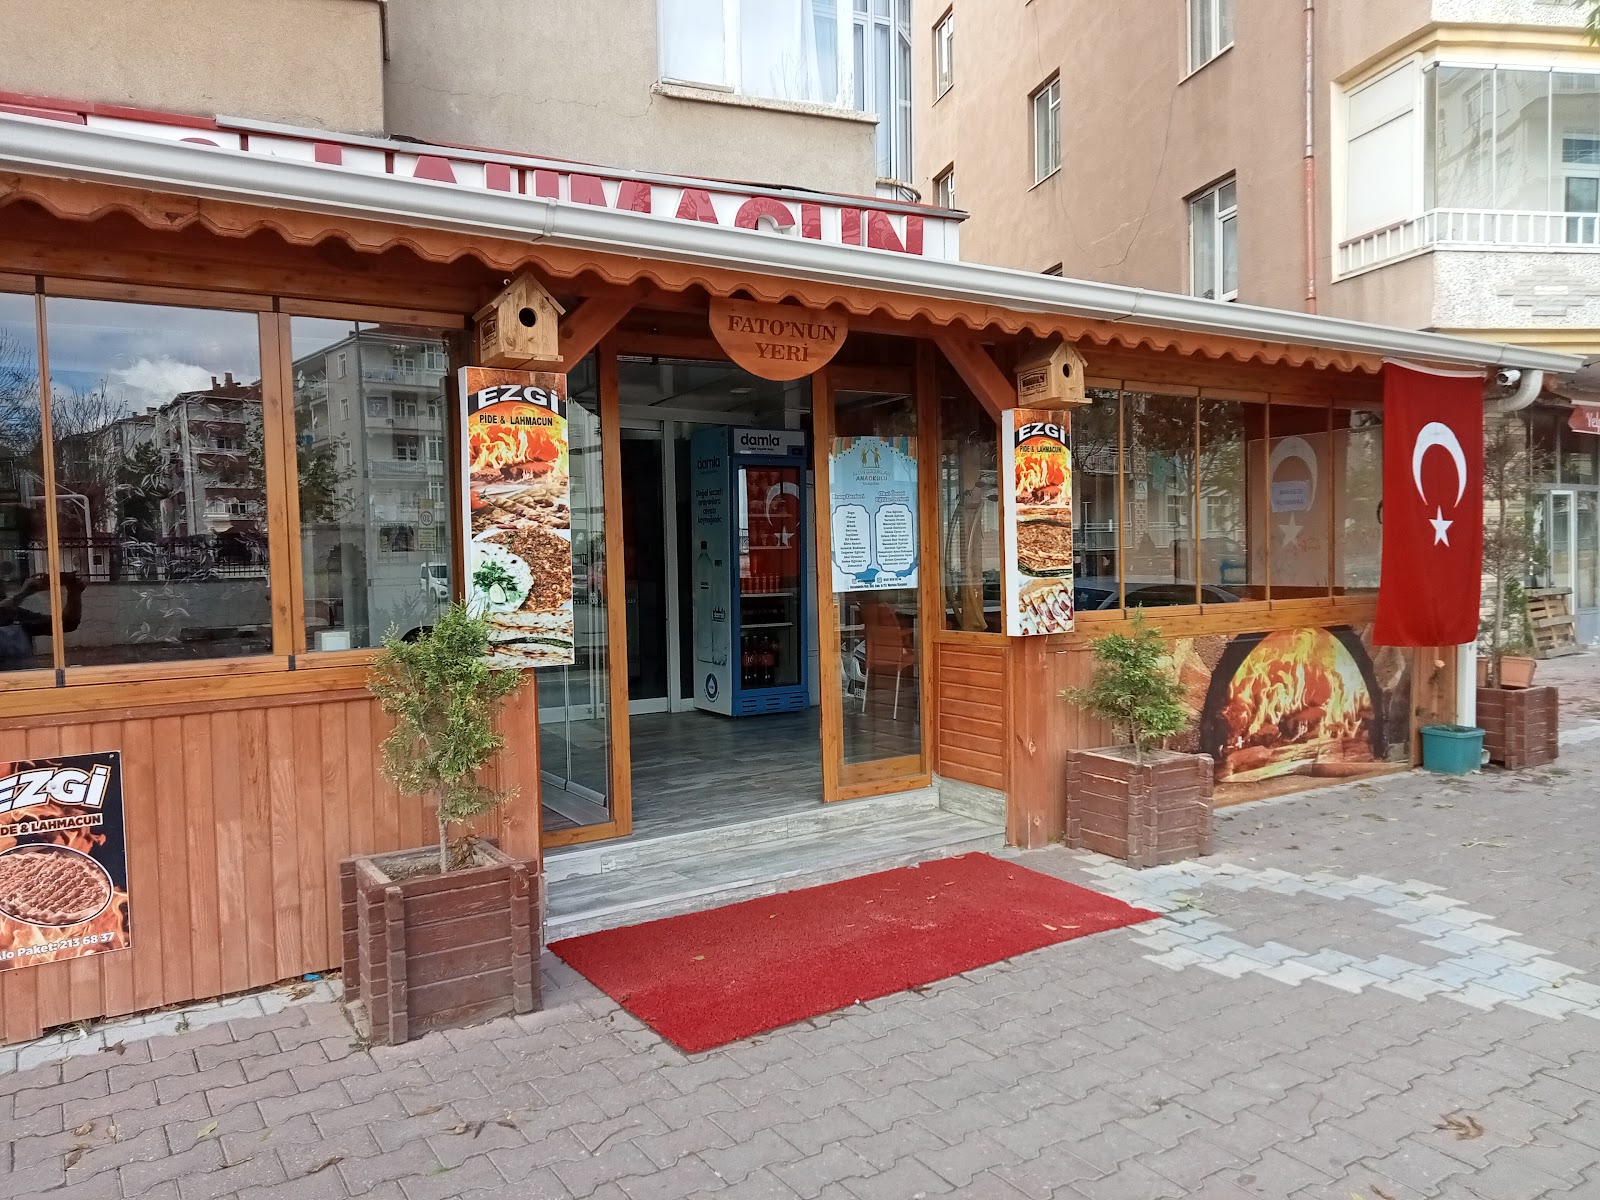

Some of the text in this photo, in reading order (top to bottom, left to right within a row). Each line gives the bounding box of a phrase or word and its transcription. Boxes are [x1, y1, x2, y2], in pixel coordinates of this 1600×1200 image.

[727, 314, 838, 342] FATO'NUN
[754, 342, 810, 362] YERİ
[479, 412, 553, 426] PİDE & LAHMACUN
[740, 432, 780, 447] damla
[697, 456, 721, 470] damla
[20, 823, 28, 834] &
[31, 814, 102, 833] LAHMACUN
[17, 942, 58, 957] Paket:
[59, 936, 81, 950] 213
[82, 933, 99, 946] 68
[100, 931, 115, 943] 37
